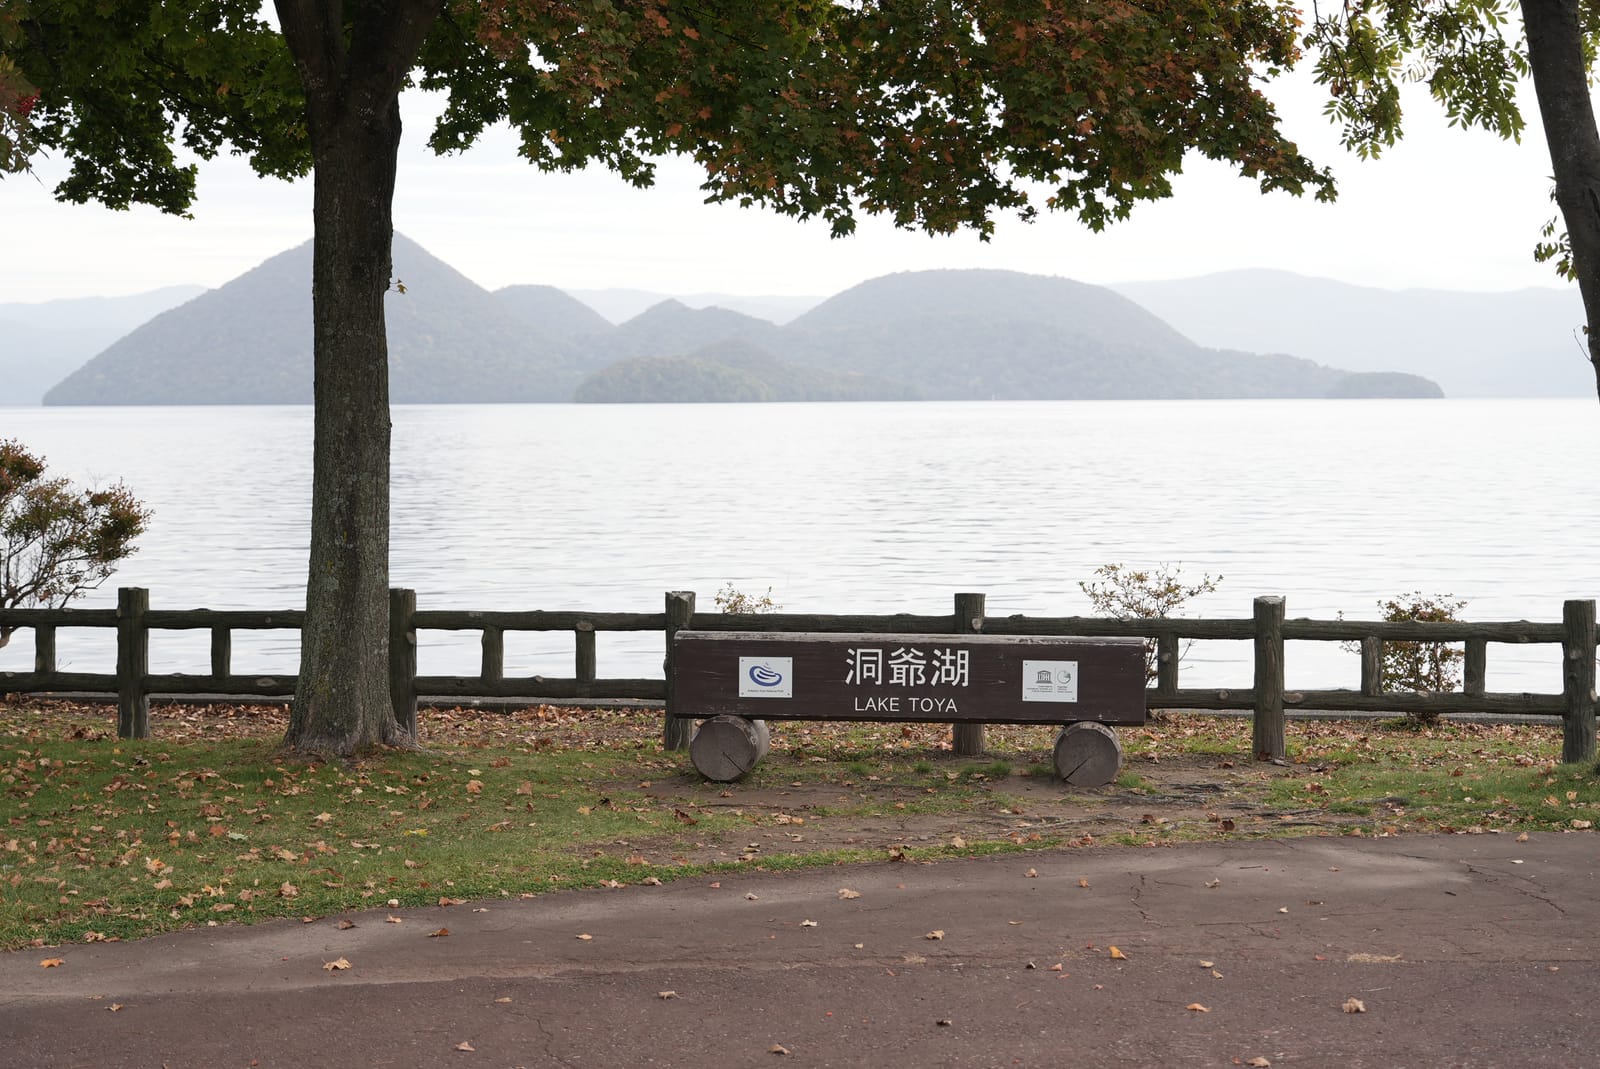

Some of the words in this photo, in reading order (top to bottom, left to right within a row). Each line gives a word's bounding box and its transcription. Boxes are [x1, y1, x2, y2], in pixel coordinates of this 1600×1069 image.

[845, 647, 969, 687] 洞爺湖
[854, 697, 900, 712] LAKE
[908, 697, 958, 713] TOYA
